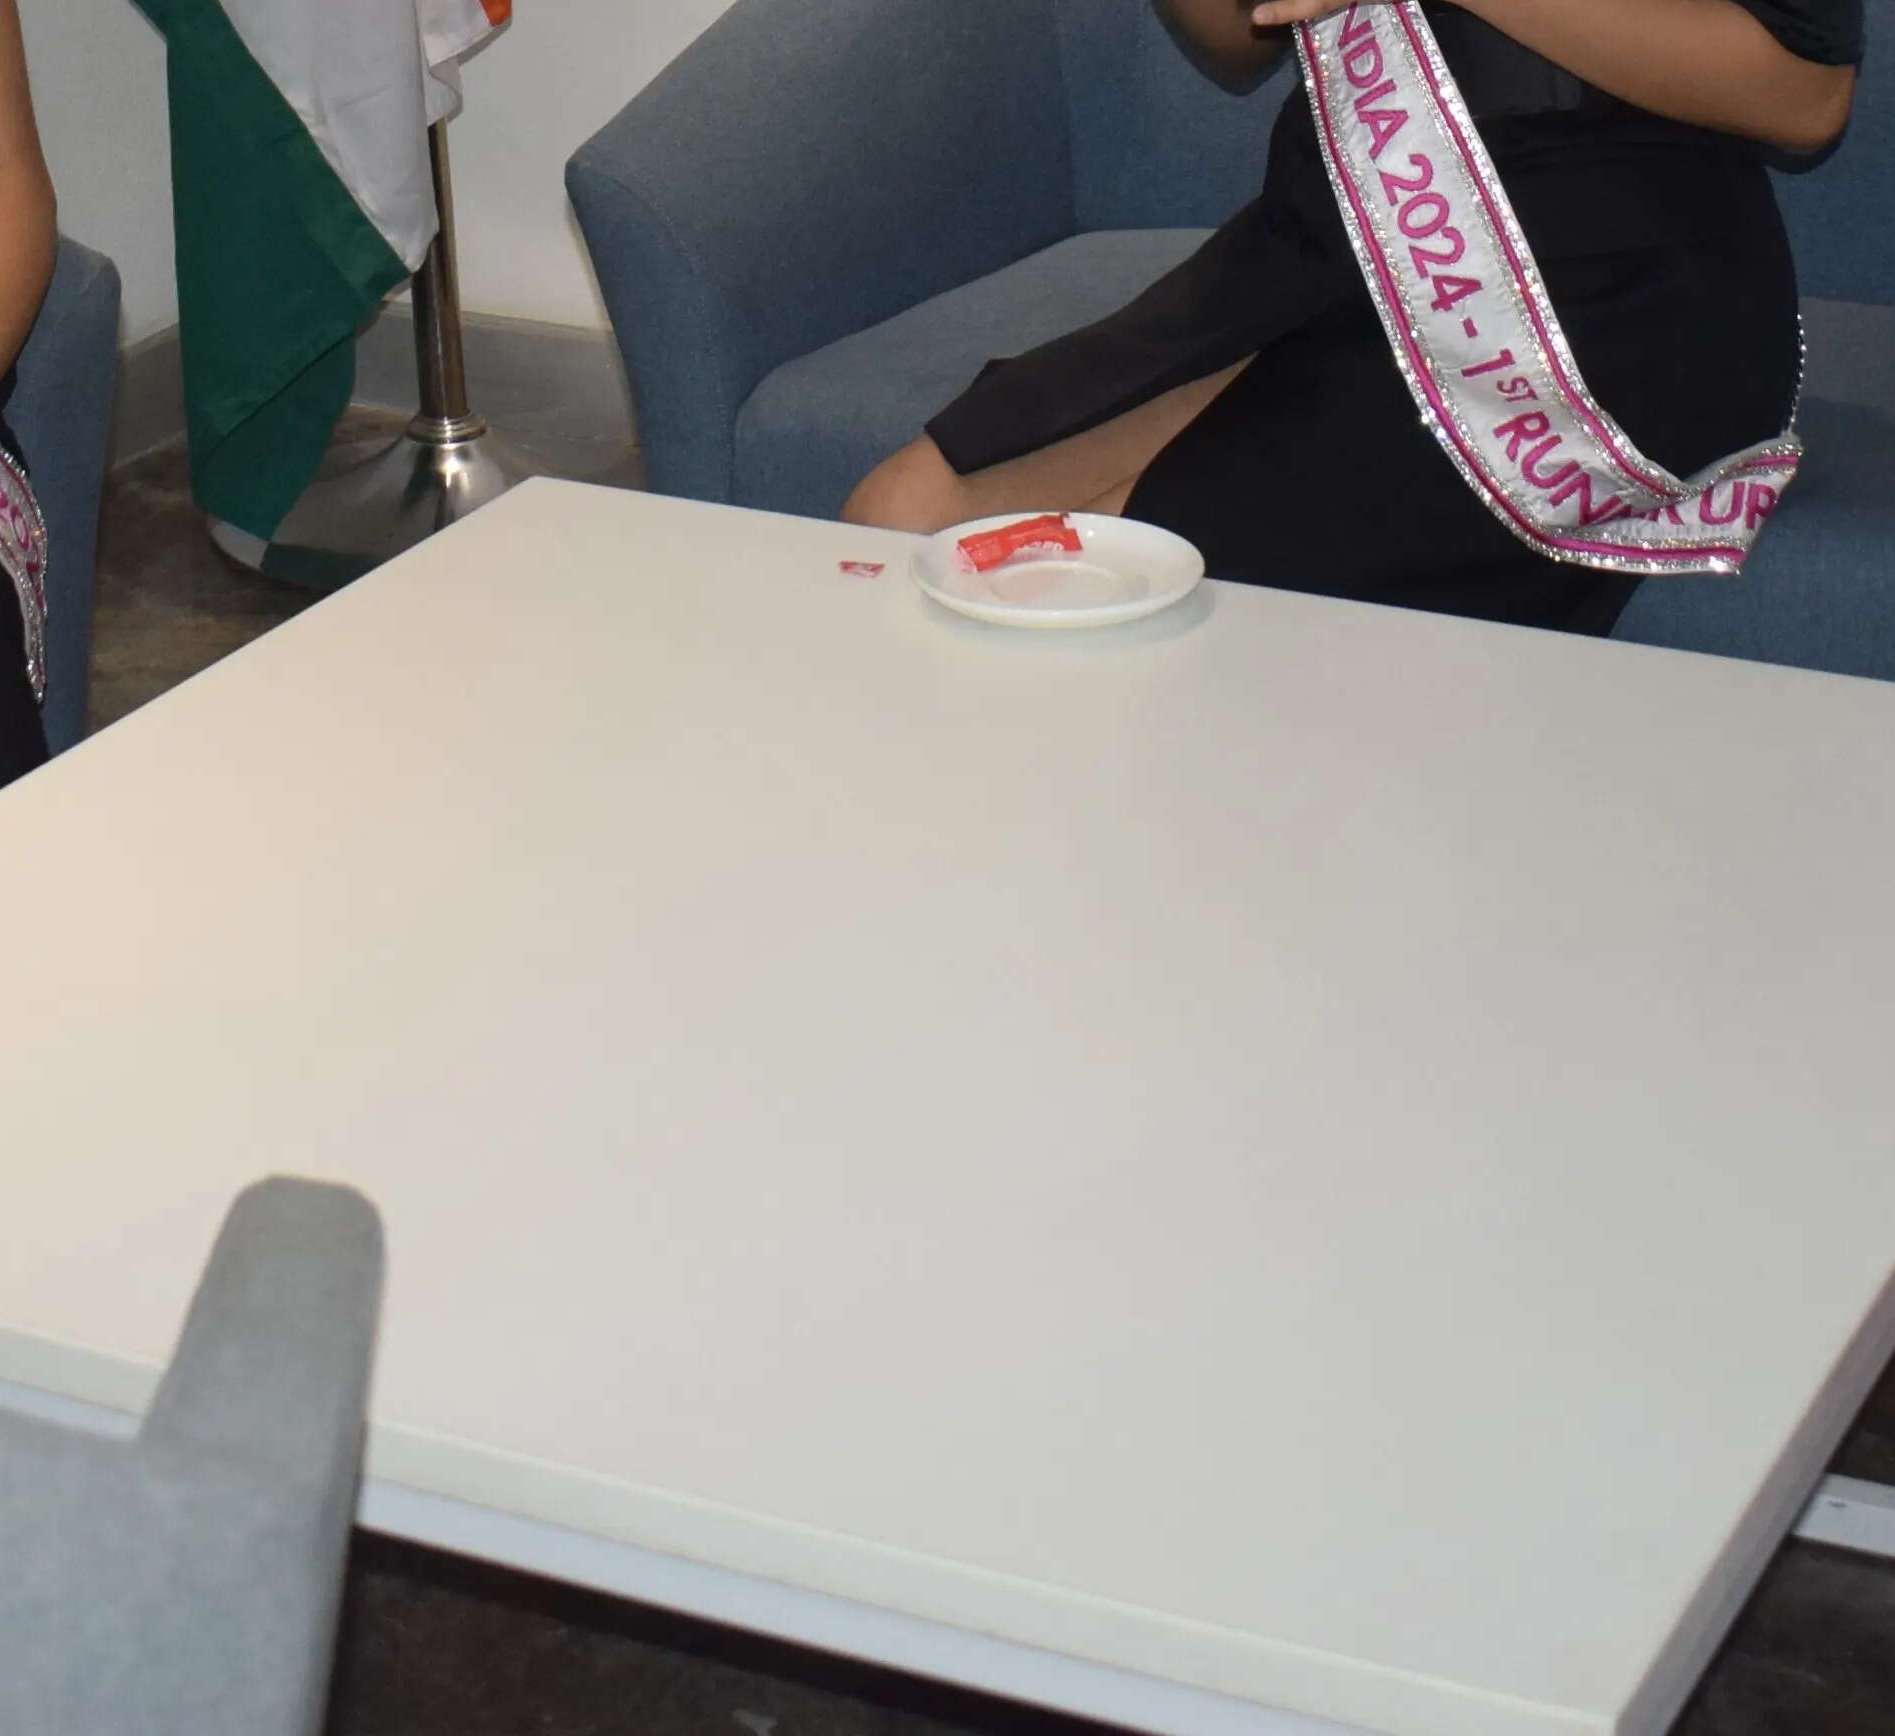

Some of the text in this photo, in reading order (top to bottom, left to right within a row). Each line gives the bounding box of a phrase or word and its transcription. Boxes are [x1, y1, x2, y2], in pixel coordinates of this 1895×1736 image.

[1338, 1, 1409, 160] NDIA
[1379, 153, 1483, 312] 2024
[1460, 347, 1540, 403] 1ST
[1699, 480, 1779, 530] UP
